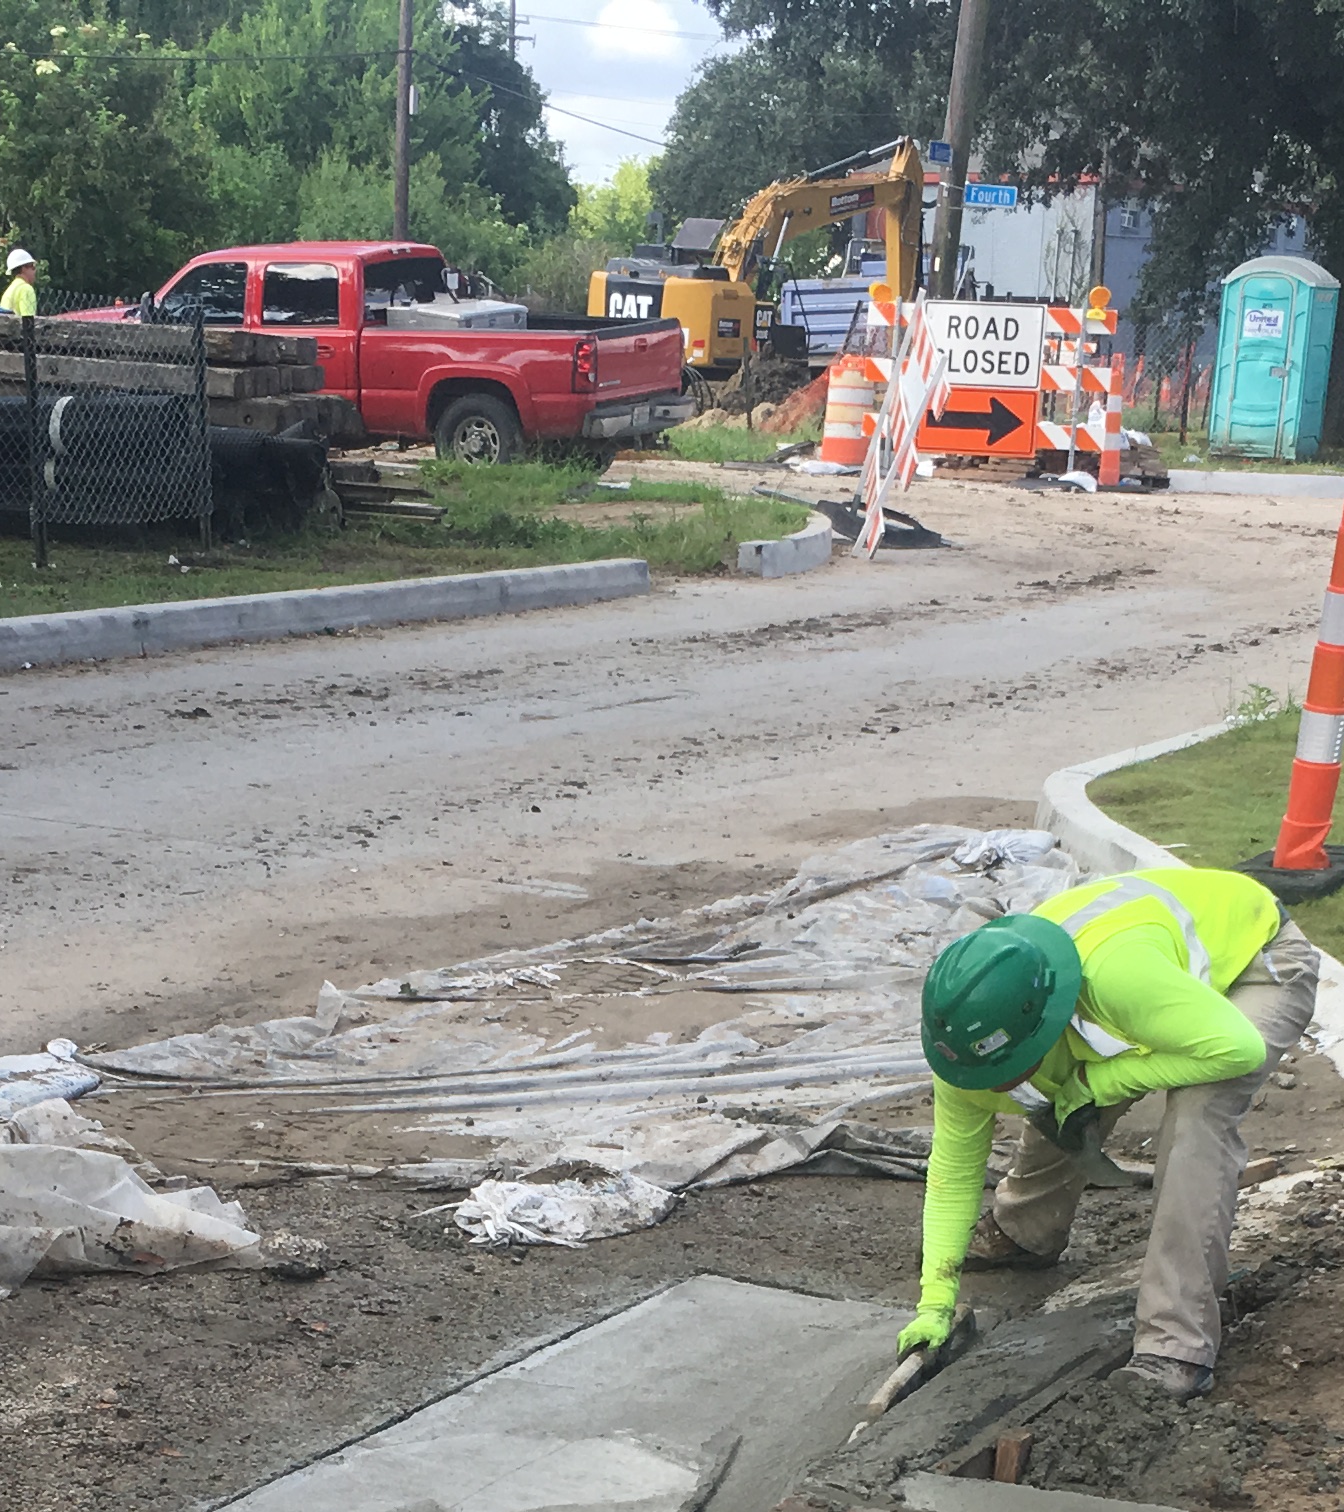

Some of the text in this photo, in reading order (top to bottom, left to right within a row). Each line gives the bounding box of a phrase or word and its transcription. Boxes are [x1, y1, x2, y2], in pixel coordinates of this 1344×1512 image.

[971, 187, 1010, 204] Fourth
[609, 292, 653, 318] CAT
[756, 310, 773, 327] CAT
[947, 315, 1019, 341] ROAD
[937, 348, 1030, 375] LOSED
